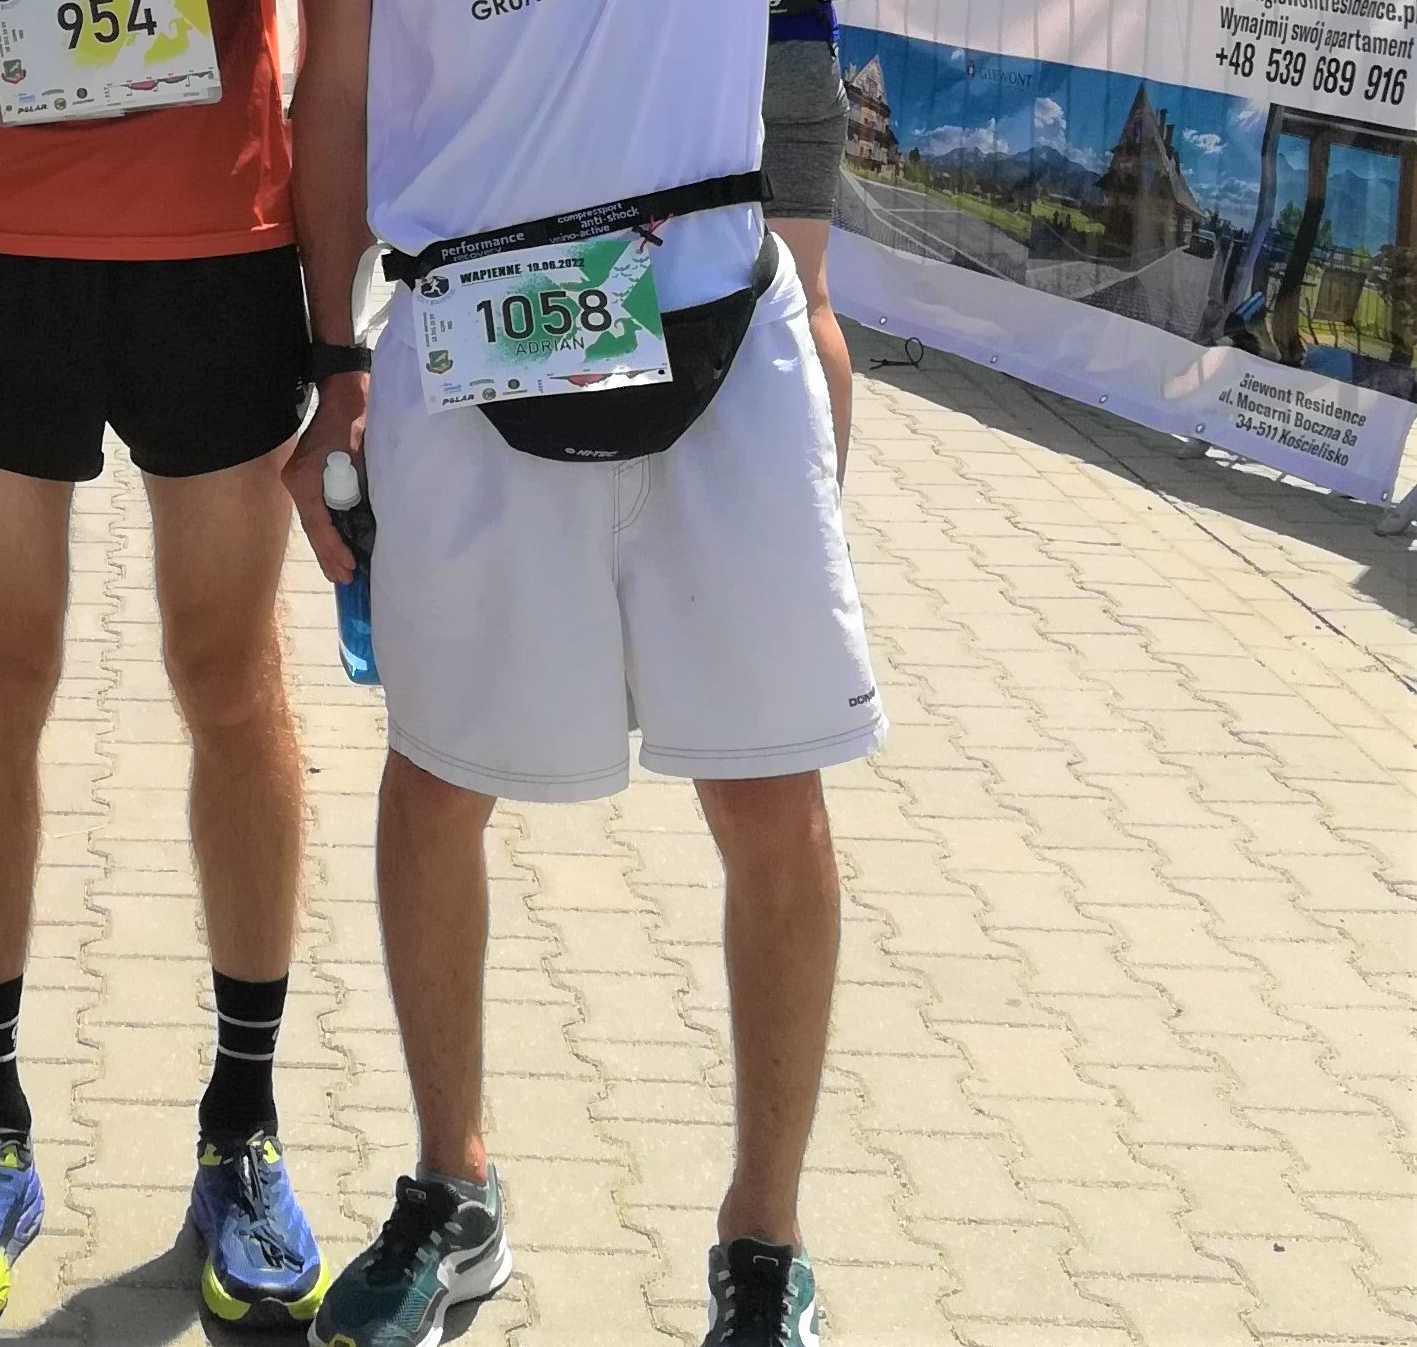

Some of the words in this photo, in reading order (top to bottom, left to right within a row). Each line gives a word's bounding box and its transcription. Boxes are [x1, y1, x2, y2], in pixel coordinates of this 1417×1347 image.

[1220, 5, 1289, 44] Wynajmij
[1291, 20, 1325, 52] swój
[1324, 28, 1415, 60] apartament
[1215, 41, 1256, 78] +48
[1265, 47, 1307, 87] 539
[1313, 55, 1357, 96] 689
[1363, 64, 1408, 106] 916
[580, 206, 640, 229] anti-shock
[440, 231, 526, 261] performance
[459, 263, 522, 284] WAPIENNE
[476, 289, 613, 344] 1058
[515, 336, 586, 357] ADRIAN
[1236, 391, 1292, 425] Mocarni
[1294, 411, 1341, 442] Boczna
[1341, 428, 1358, 448] 8a
[1295, 390, 1367, 427] Residence
[1235, 413, 1279, 441] 34-511
[1277, 428, 1350, 467] Kościelisko
